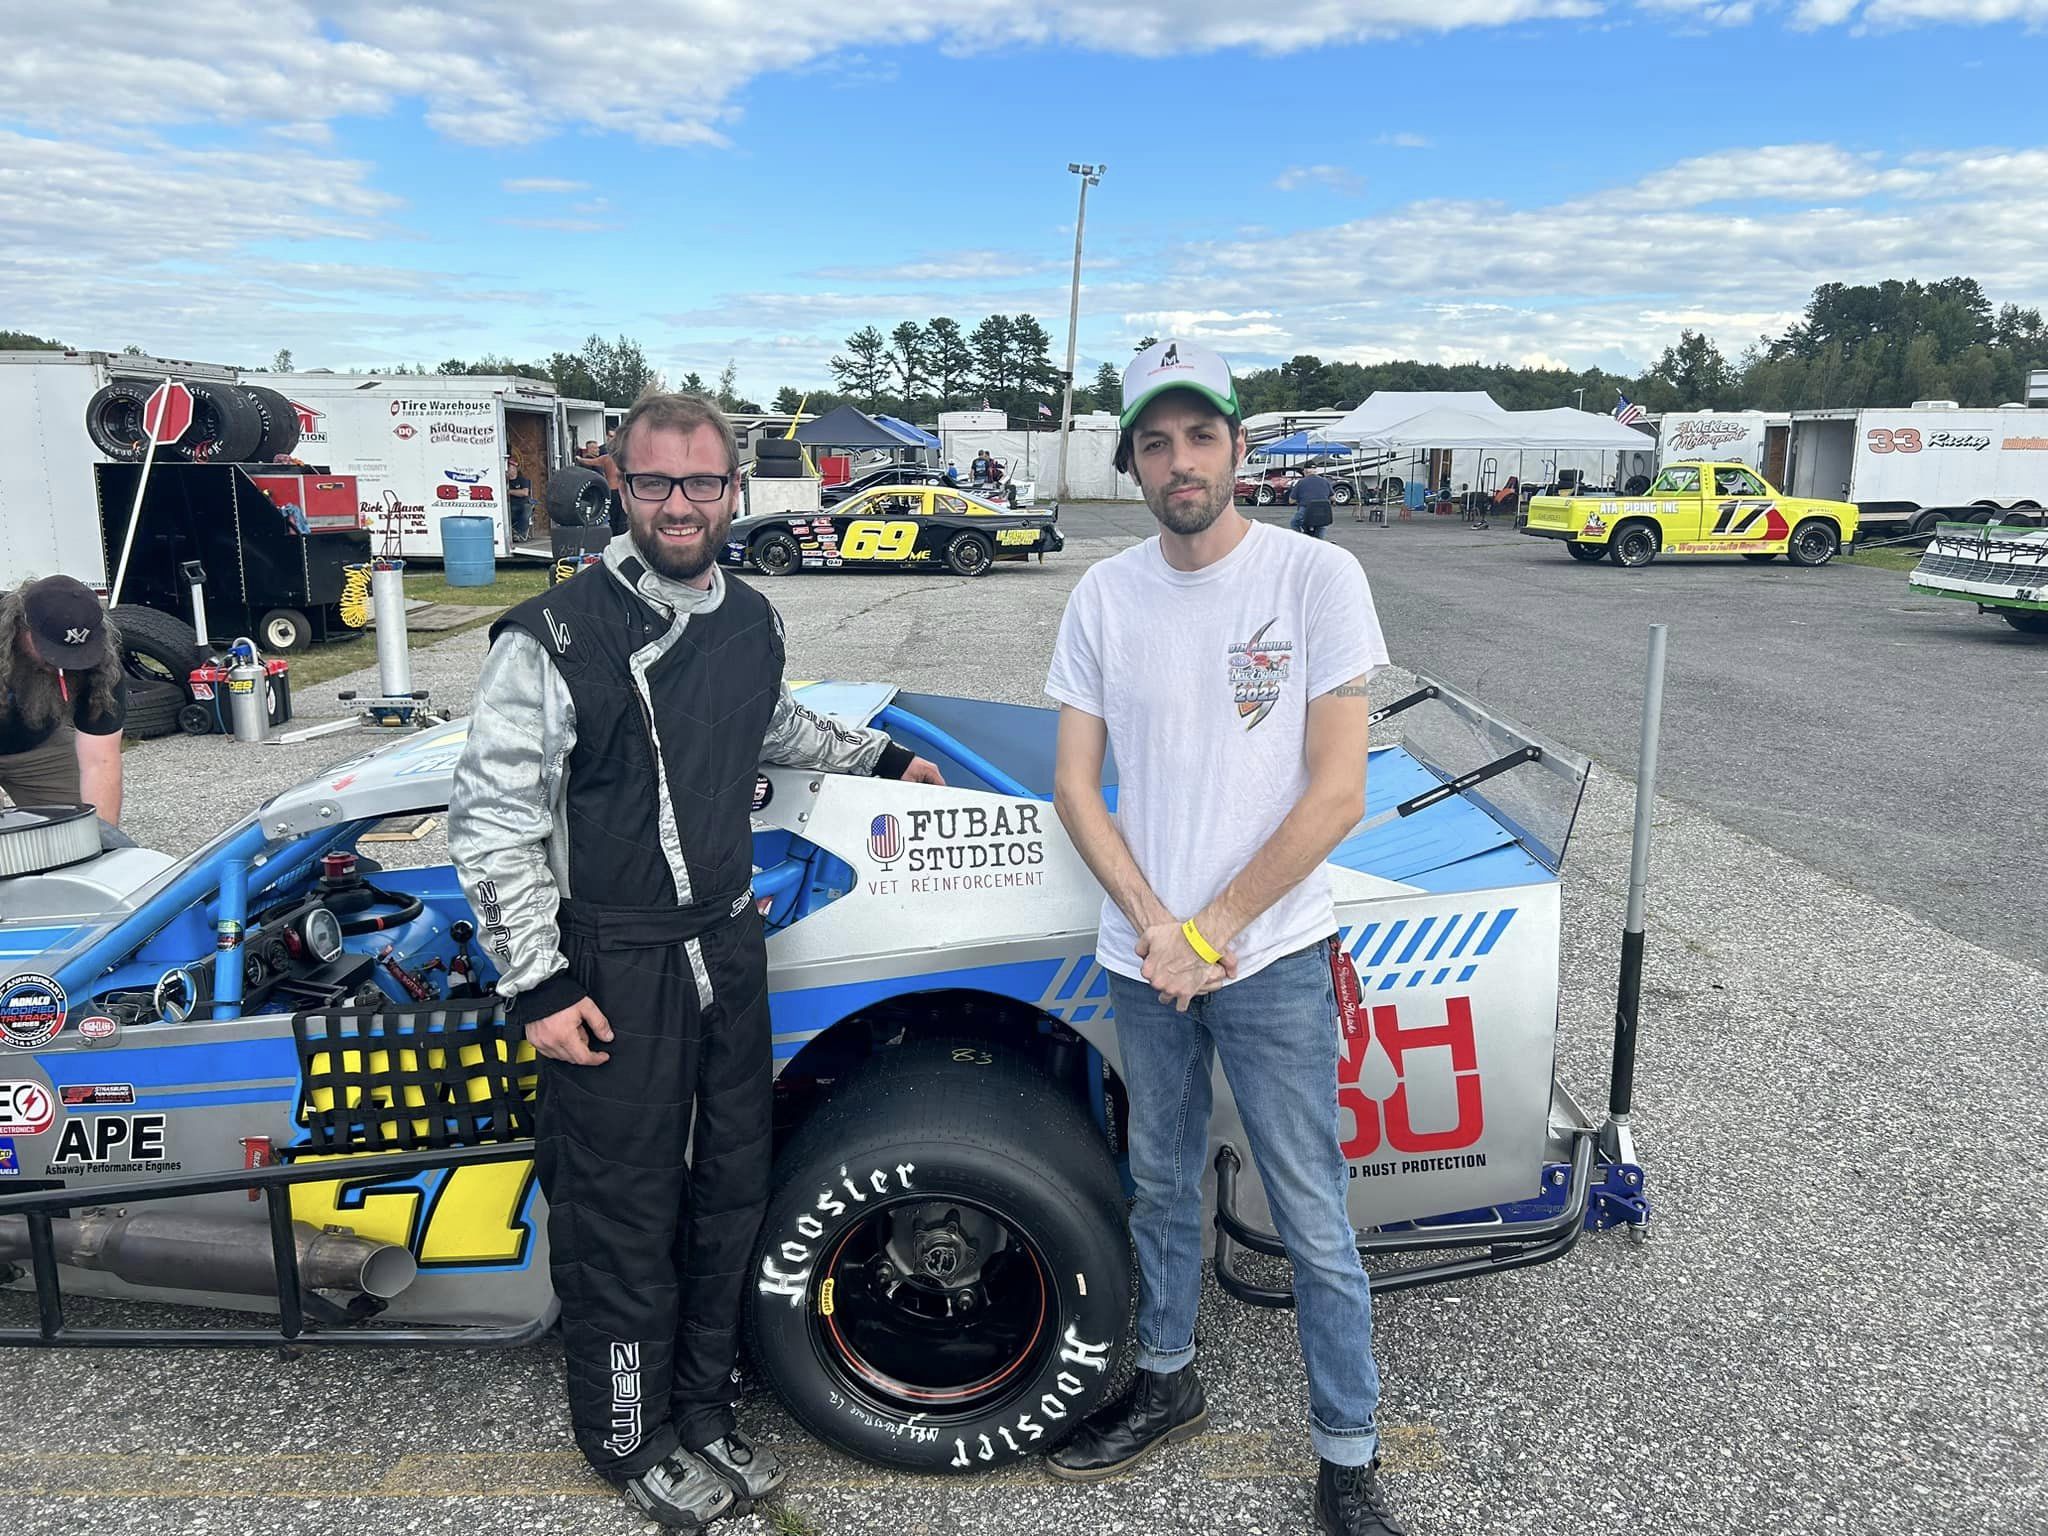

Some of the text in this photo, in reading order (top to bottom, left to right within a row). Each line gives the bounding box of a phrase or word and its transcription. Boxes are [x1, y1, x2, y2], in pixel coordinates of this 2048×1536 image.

[401, 400, 491, 411] Tire Warehouse
[398, 427, 413, 436] DQ
[430, 422, 494, 436] KidQuarters
[1687, 420, 1740, 434] McKee
[431, 434, 495, 445] Child Care Center
[1667, 429, 1747, 452] Motorsports
[1867, 428, 1923, 454] 33
[1928, 431, 1991, 451] Racing
[360, 501, 384, 513] Rick
[1600, 502, 1679, 514] ATA PIPING INC
[1710, 500, 1777, 536] 17
[839, 519, 920, 561] 69
[910, 550, 931, 560] ME
[64, 628, 91, 645] NY
[1249, 640, 1293, 652] ANNUAL
[1234, 686, 1280, 703] 2022
[907, 803, 1042, 841] FUBAR
[909, 841, 1044, 872] STUDIOS
[868, 871, 1044, 896] VET REINFORCEMENT
[6, 975, 64, 999] ANNIVERSARY
[0, 1004, 56, 1016] MODIFIED
[9, 996, 51, 1008] MONACO
[0, 1013, 55, 1023] TRI-TRACK
[53, 1115, 166, 1164] APE
[45, 1159, 182, 1177] Ashaway Performance Engines
[1362, 1162, 1397, 1178] RUST
[1401, 1153, 1487, 1174] PROTECTION
[758, 1163, 915, 1309] Hoosier
[951, 1323, 1114, 1467] Hoosier
